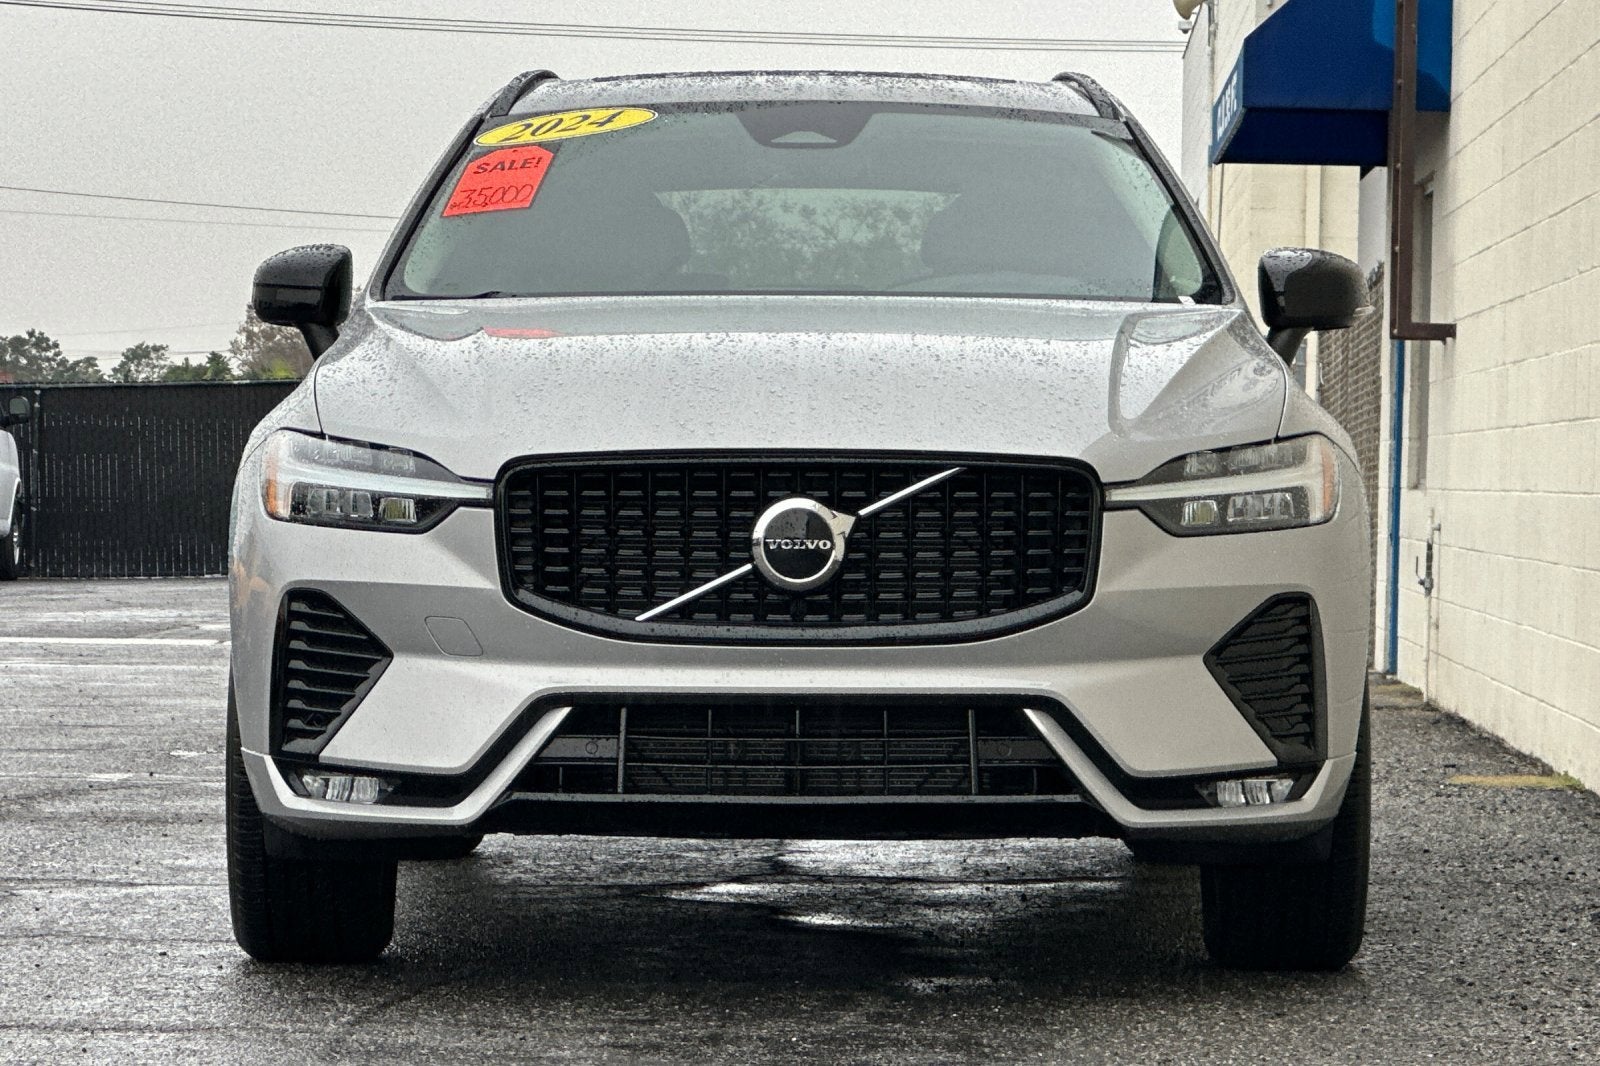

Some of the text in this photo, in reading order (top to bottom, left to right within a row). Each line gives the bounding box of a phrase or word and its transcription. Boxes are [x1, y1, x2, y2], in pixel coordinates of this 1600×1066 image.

[497, 109, 625, 143] 2024
[473, 156, 542, 175] SALE!
[765, 539, 832, 550] VOLVO
